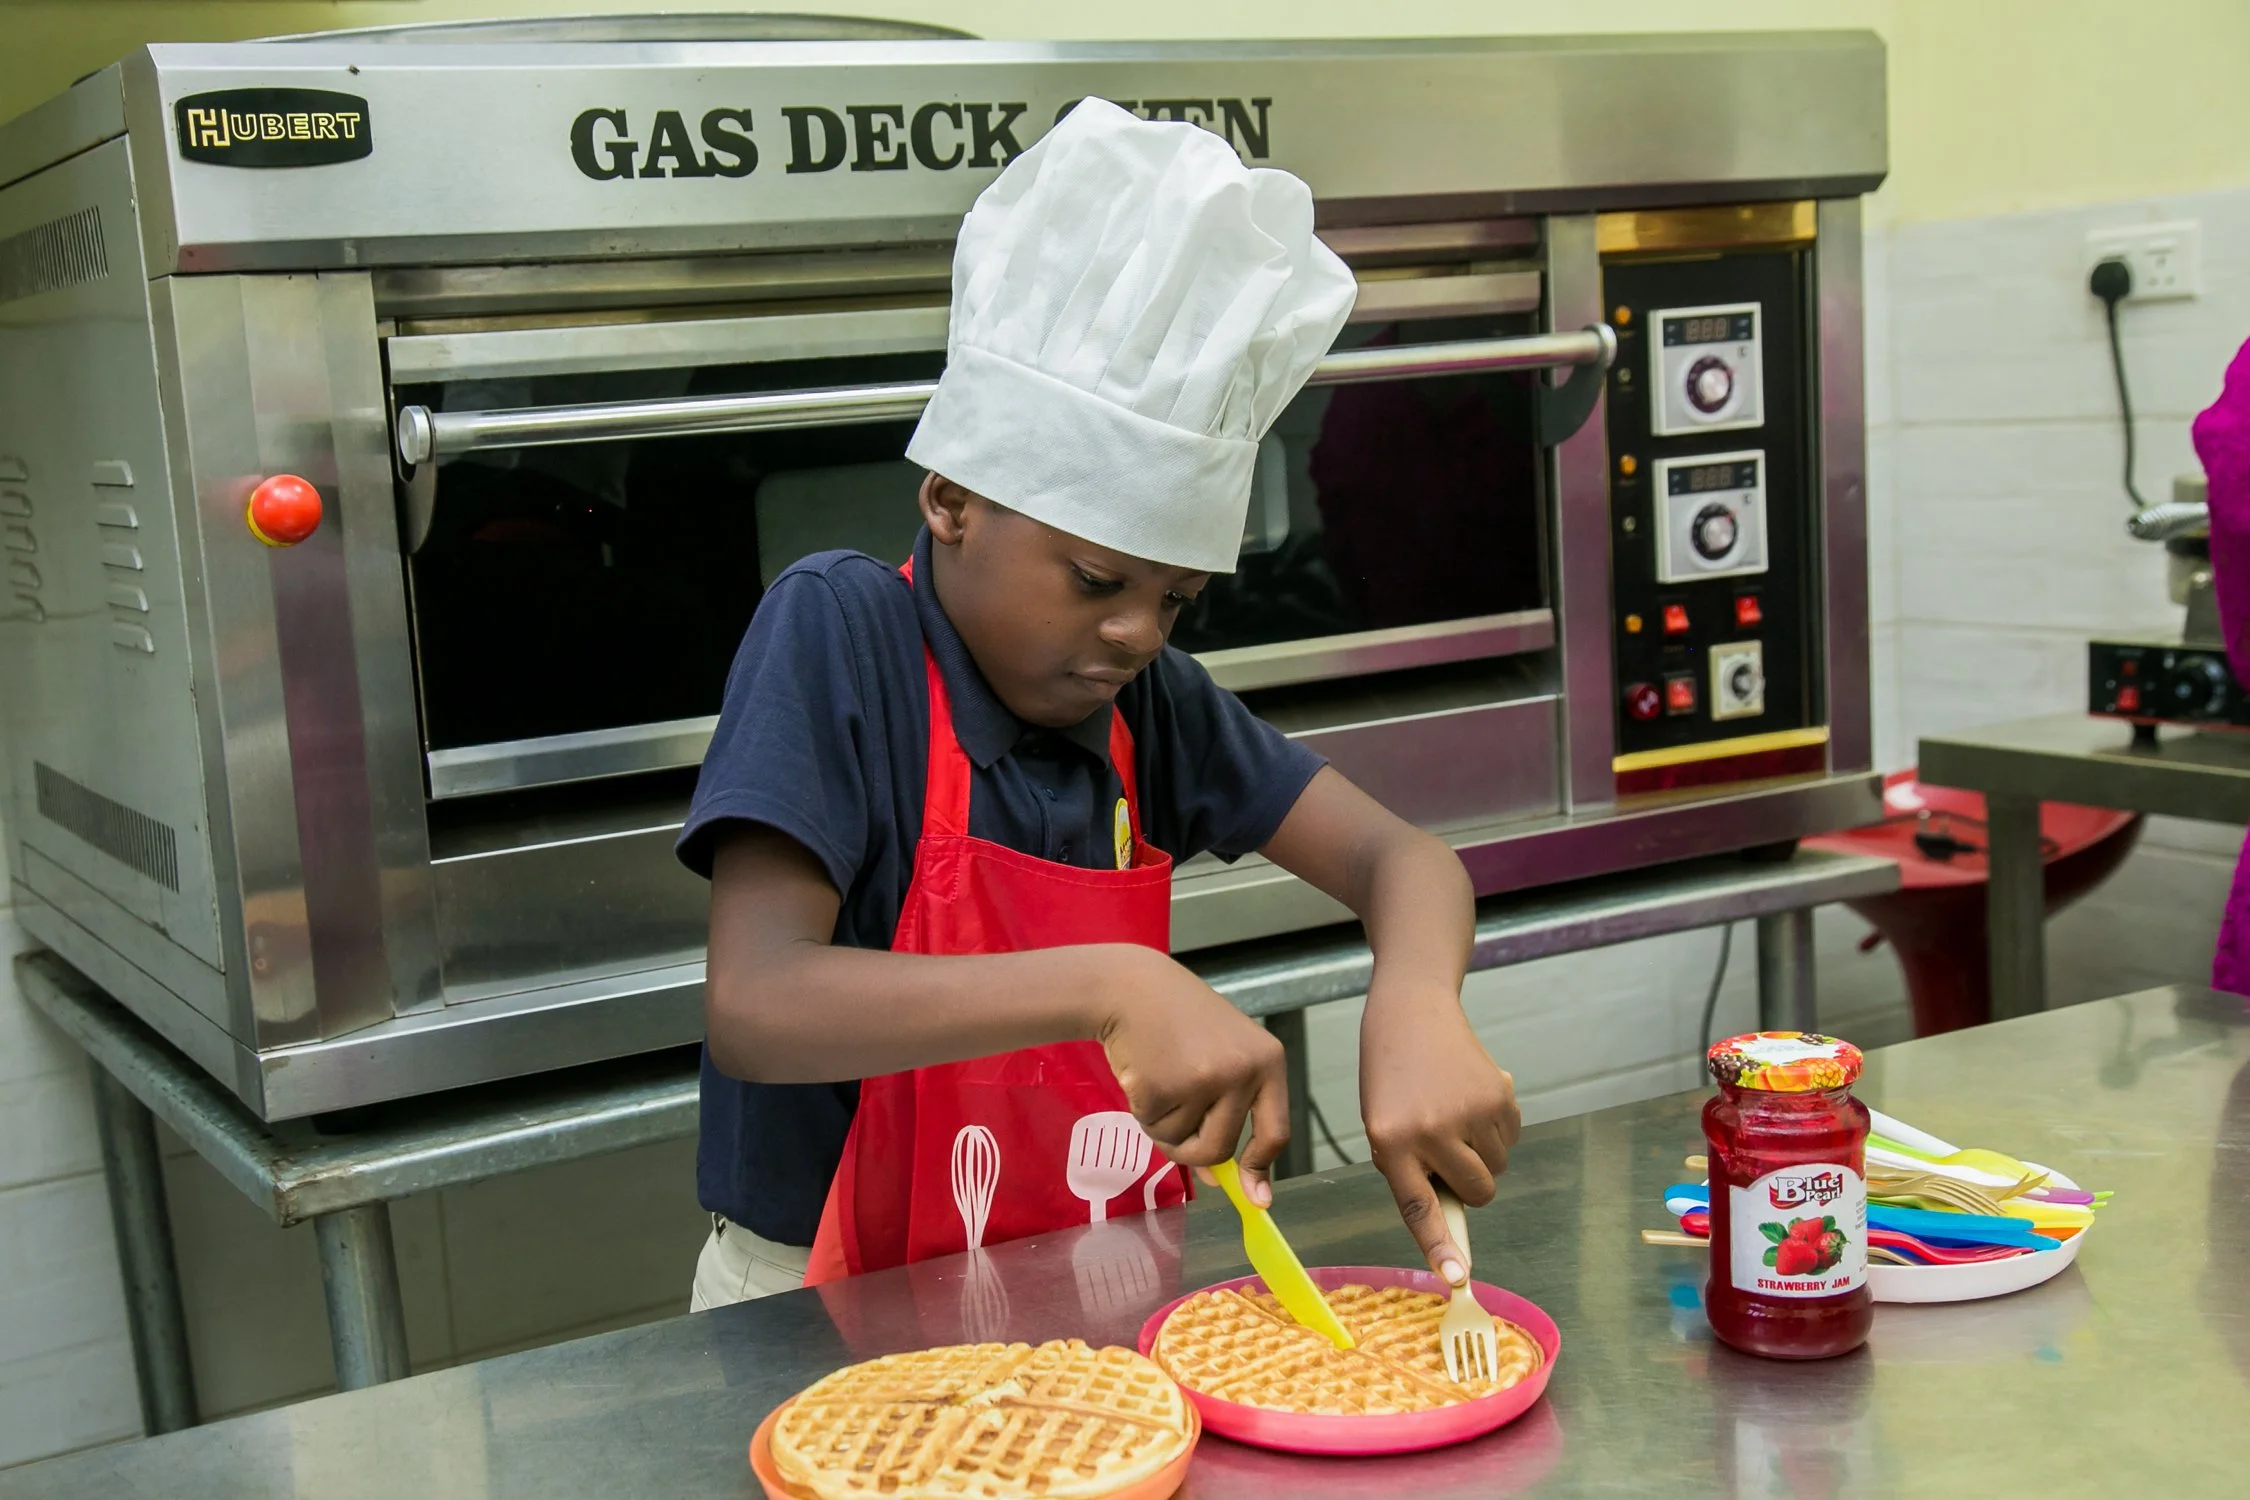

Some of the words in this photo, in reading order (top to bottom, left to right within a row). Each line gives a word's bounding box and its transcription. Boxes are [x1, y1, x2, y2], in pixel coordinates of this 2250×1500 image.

[187, 108, 361, 147] HUBERT
[570, 107, 759, 181] GAS
[780, 102, 1027, 174] DECK
[1775, 1176, 1841, 1202] Blue
[1805, 1187, 1841, 1202] Pearl
[1757, 1278, 1827, 1291] STRAWBERRY
[1832, 1276, 1850, 1289] JAM
